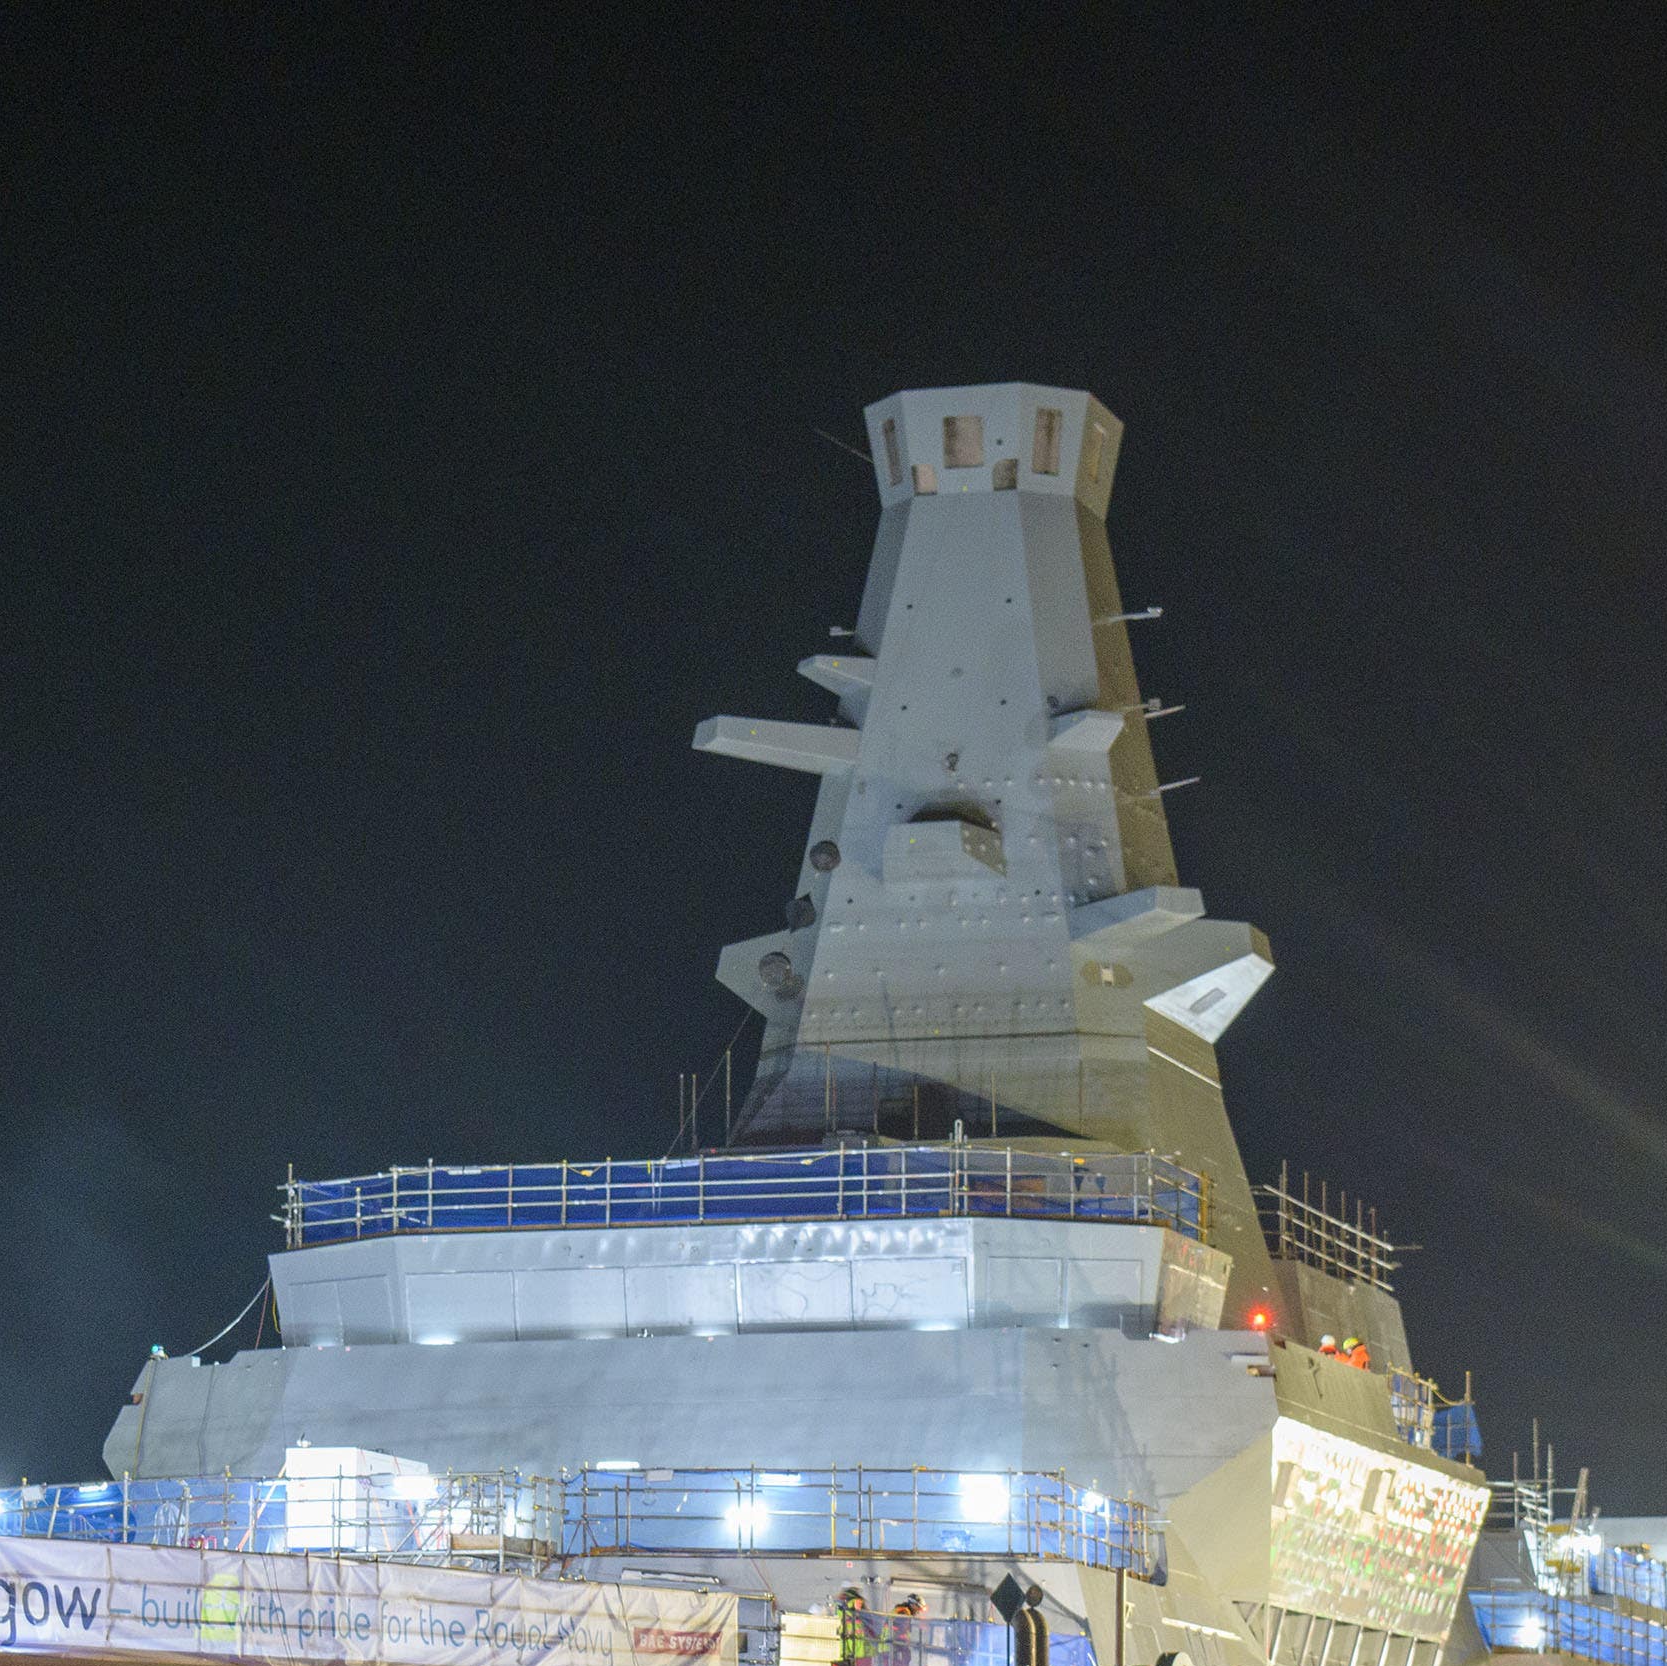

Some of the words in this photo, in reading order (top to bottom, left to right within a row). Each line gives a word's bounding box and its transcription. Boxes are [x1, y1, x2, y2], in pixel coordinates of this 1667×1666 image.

[140, 1583, 215, 1630] built
[221, 1589, 288, 1635] with
[297, 1598, 372, 1650] pride
[381, 1599, 412, 1646] for
[419, 1605, 466, 1648] the
[474, 1608, 552, 1663] Royal
[639, 1633, 665, 1650] BAE
